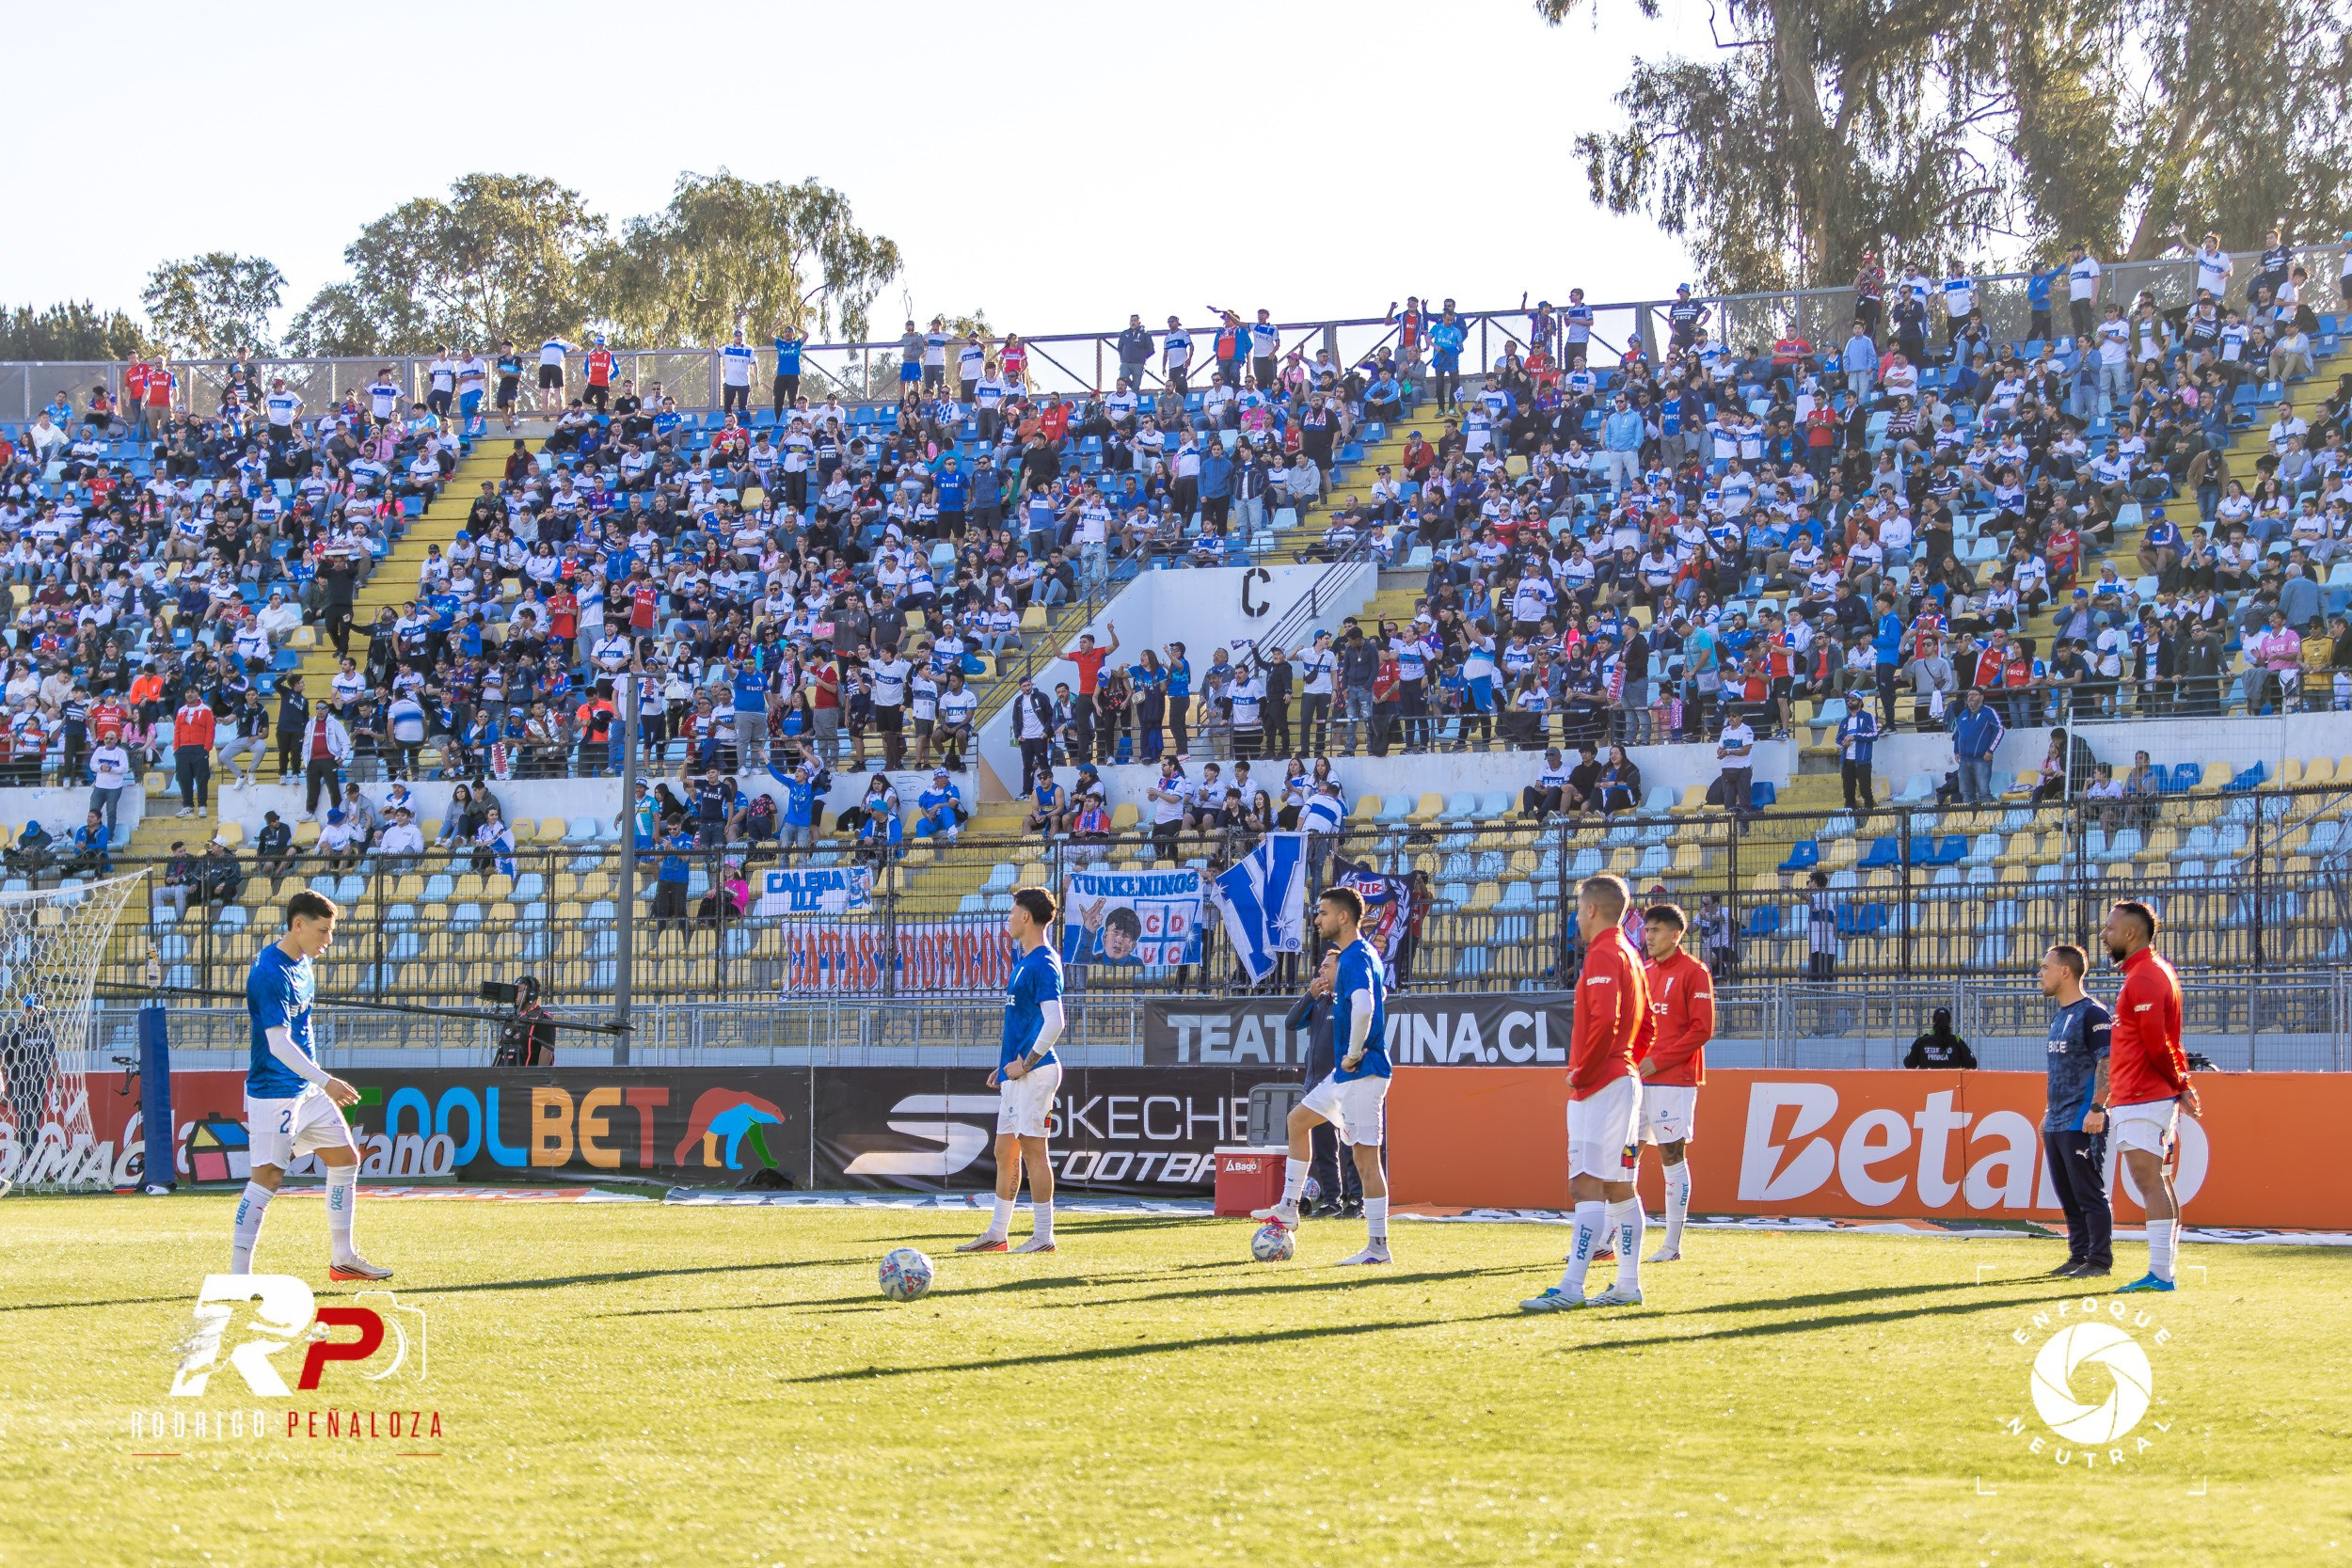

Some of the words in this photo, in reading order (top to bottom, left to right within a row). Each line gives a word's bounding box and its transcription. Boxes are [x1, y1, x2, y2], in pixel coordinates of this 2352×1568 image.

[1242, 568, 1271, 617] C
[767, 871, 846, 894] CALERA
[1070, 871, 1200, 896] TUNKENINOS
[1146, 915, 1161, 933] C
[1170, 913, 1184, 932] D
[1143, 946, 1154, 964] U
[1168, 945, 1182, 964] C
[2047, 1040, 2068, 1053] BICE
[280, 1110, 292, 1134] 2
[285, 1125, 455, 1177] tano
[1235, 1161, 1257, 1173] Bagó
[1576, 1224, 1594, 1261] 1XBET
